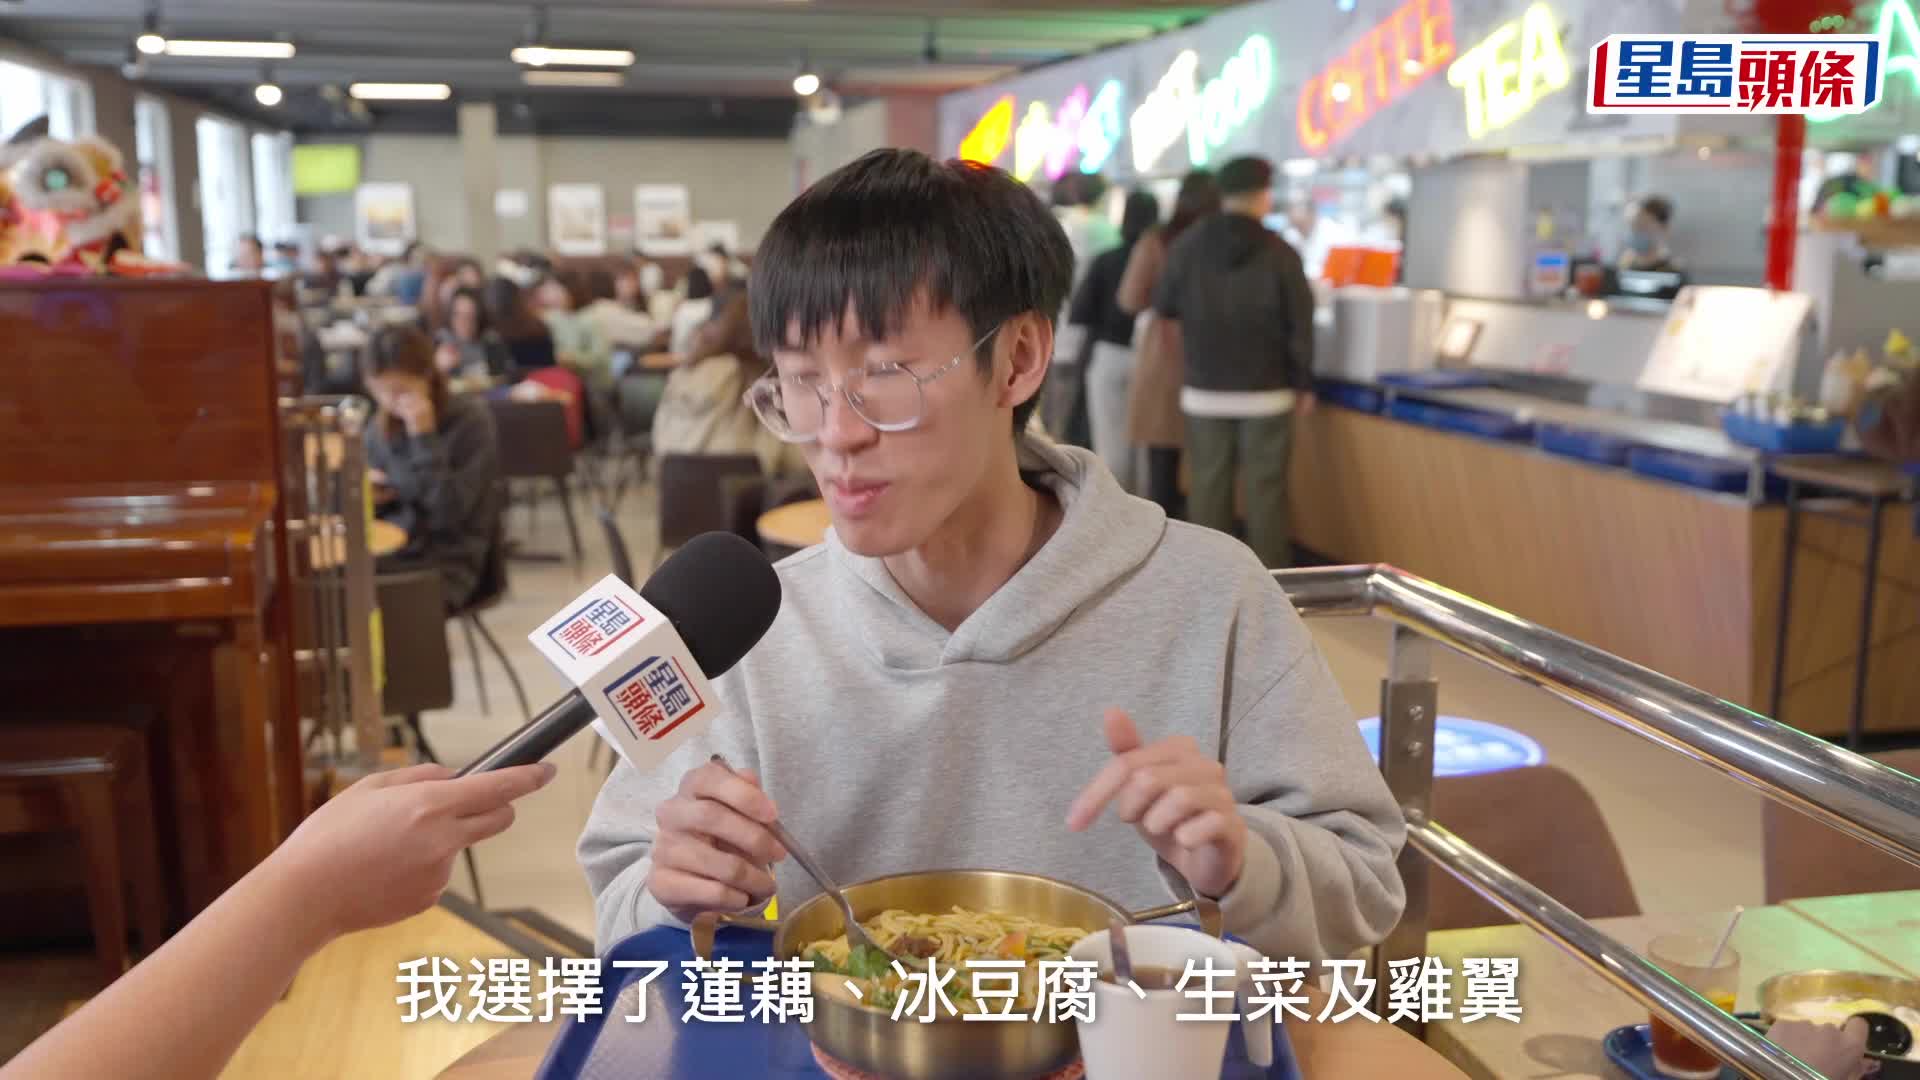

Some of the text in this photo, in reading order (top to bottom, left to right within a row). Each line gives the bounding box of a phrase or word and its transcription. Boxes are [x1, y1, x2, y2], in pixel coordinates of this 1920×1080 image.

[1448, 3, 1568, 138] TEA
[559, 618, 604, 655] 頭條
[586, 600, 630, 636] 星島
[616, 679, 665, 735] 頭條
[644, 661, 691, 717] 星島
